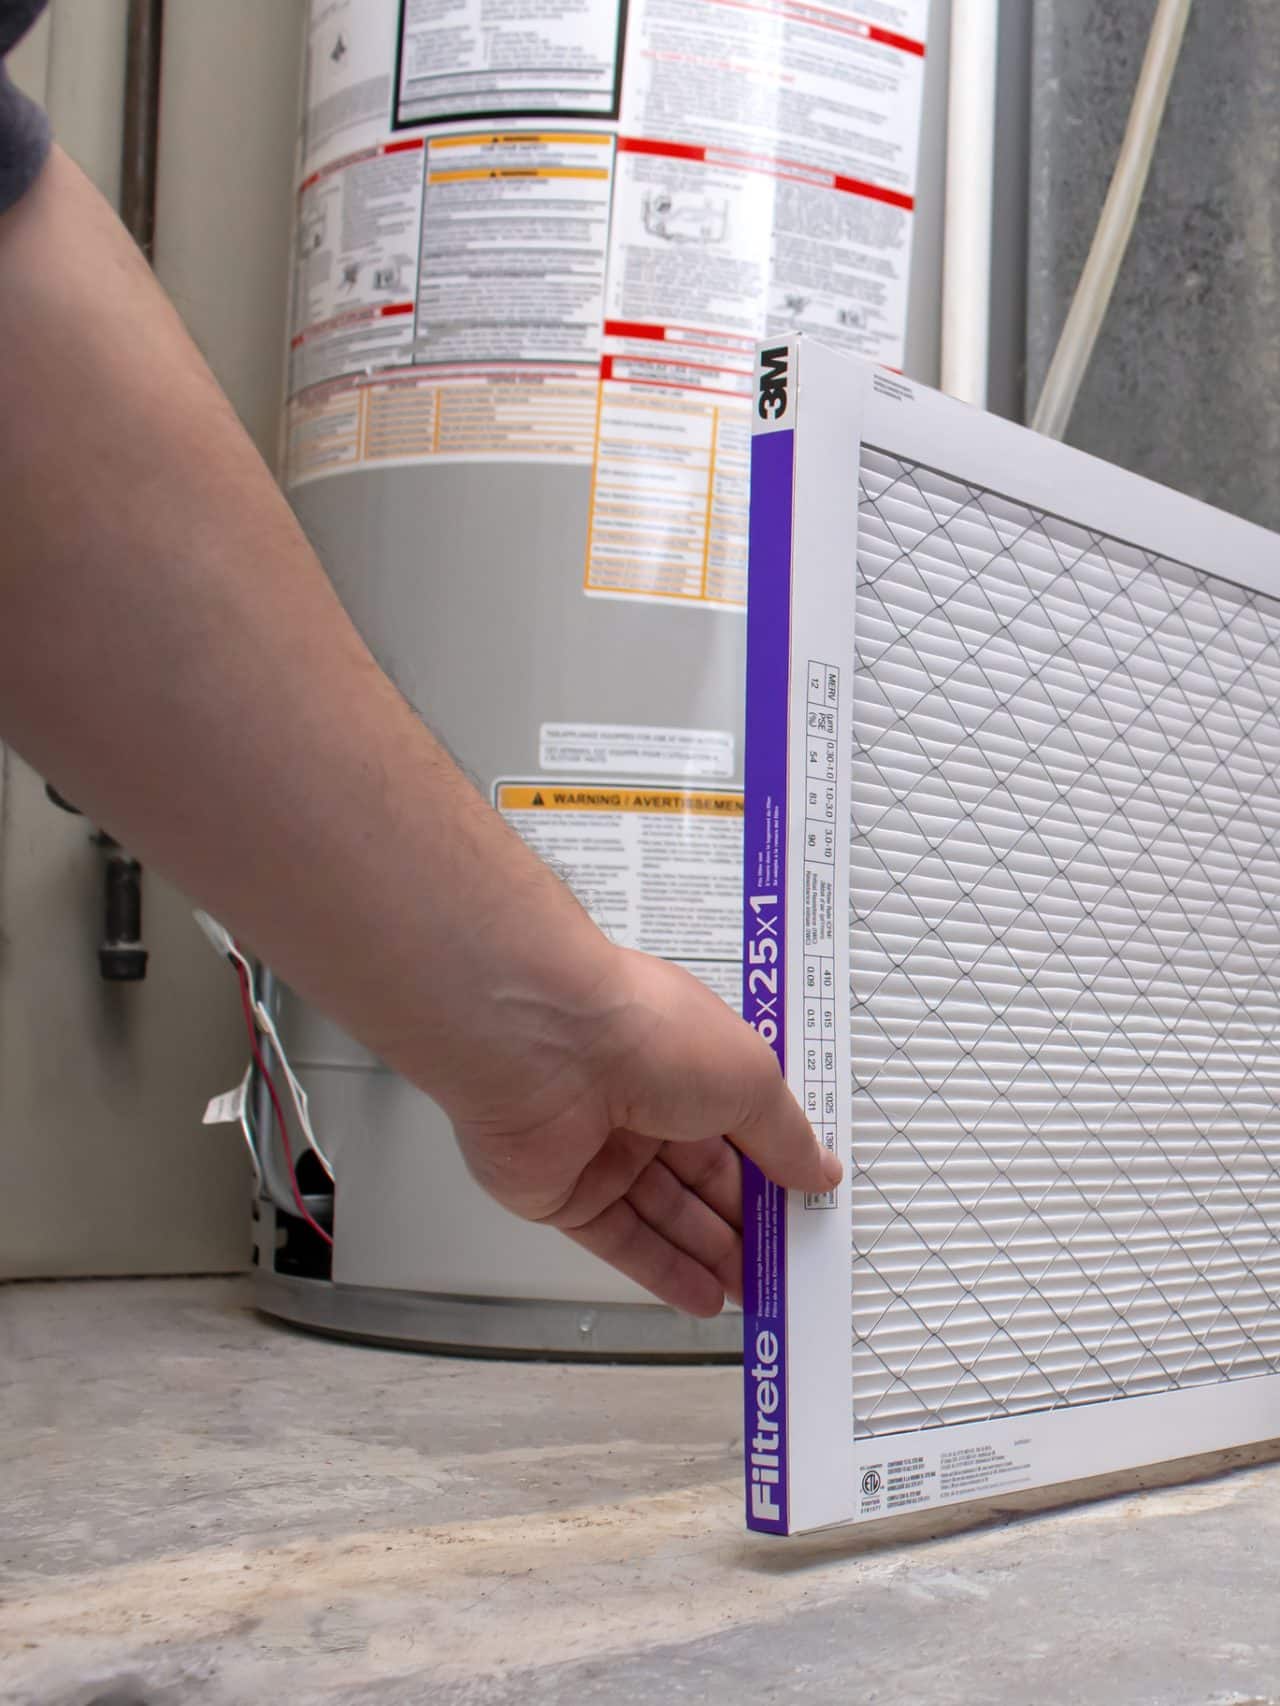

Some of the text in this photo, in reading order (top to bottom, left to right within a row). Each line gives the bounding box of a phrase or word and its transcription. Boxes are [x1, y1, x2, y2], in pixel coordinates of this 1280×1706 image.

[759, 346, 788, 420] 3M
[811, 678, 819, 689] 12
[827, 673, 836, 701] MERV
[818, 712, 826, 731] PSE
[553, 793, 620, 806] WARNING
[633, 796, 744, 811] AVERTISSEMEN
[808, 751, 818, 847] 54 83 90
[825, 787, 833, 818] 1.0-3.0
[824, 829, 833, 858] 3.0-10
[749, 895, 778, 1048] 6x25x1
[823, 969, 832, 987] 410
[824, 1010, 832, 1028] 615
[807, 966, 816, 1111] 0.09 0.15 0.22 0.31
[824, 1052, 833, 1070] 820
[824, 1091, 834, 1114] 1025
[751, 1330, 780, 1521] Filtrete
